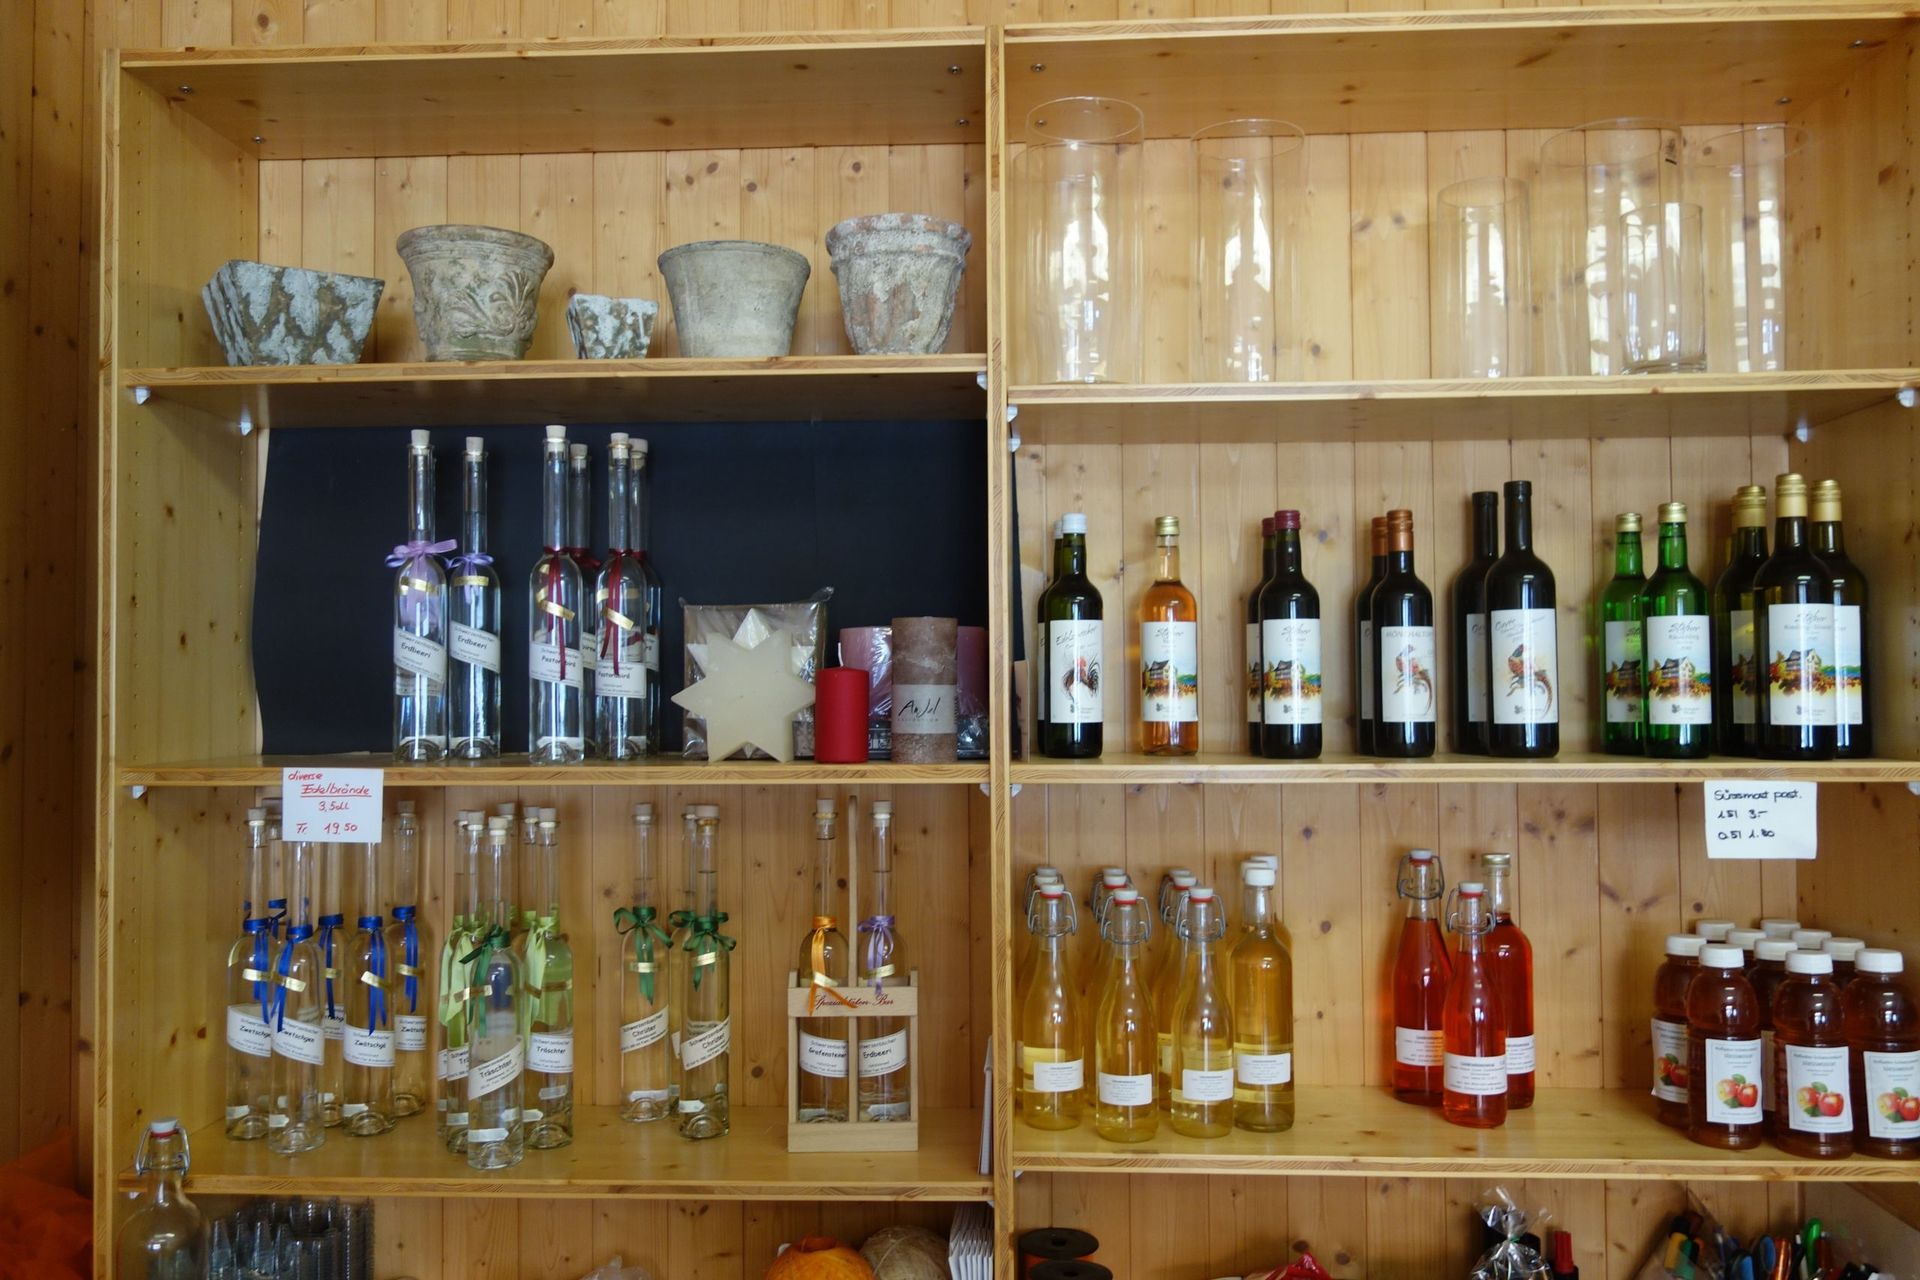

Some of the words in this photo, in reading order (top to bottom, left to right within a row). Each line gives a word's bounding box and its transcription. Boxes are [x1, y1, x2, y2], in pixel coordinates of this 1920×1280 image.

[457, 635, 487, 649] Erdbeeri
[401, 642, 431, 658] Erdbeeri
[288, 771, 323, 781] diverse
[301, 782, 370, 795] Edelbrände
